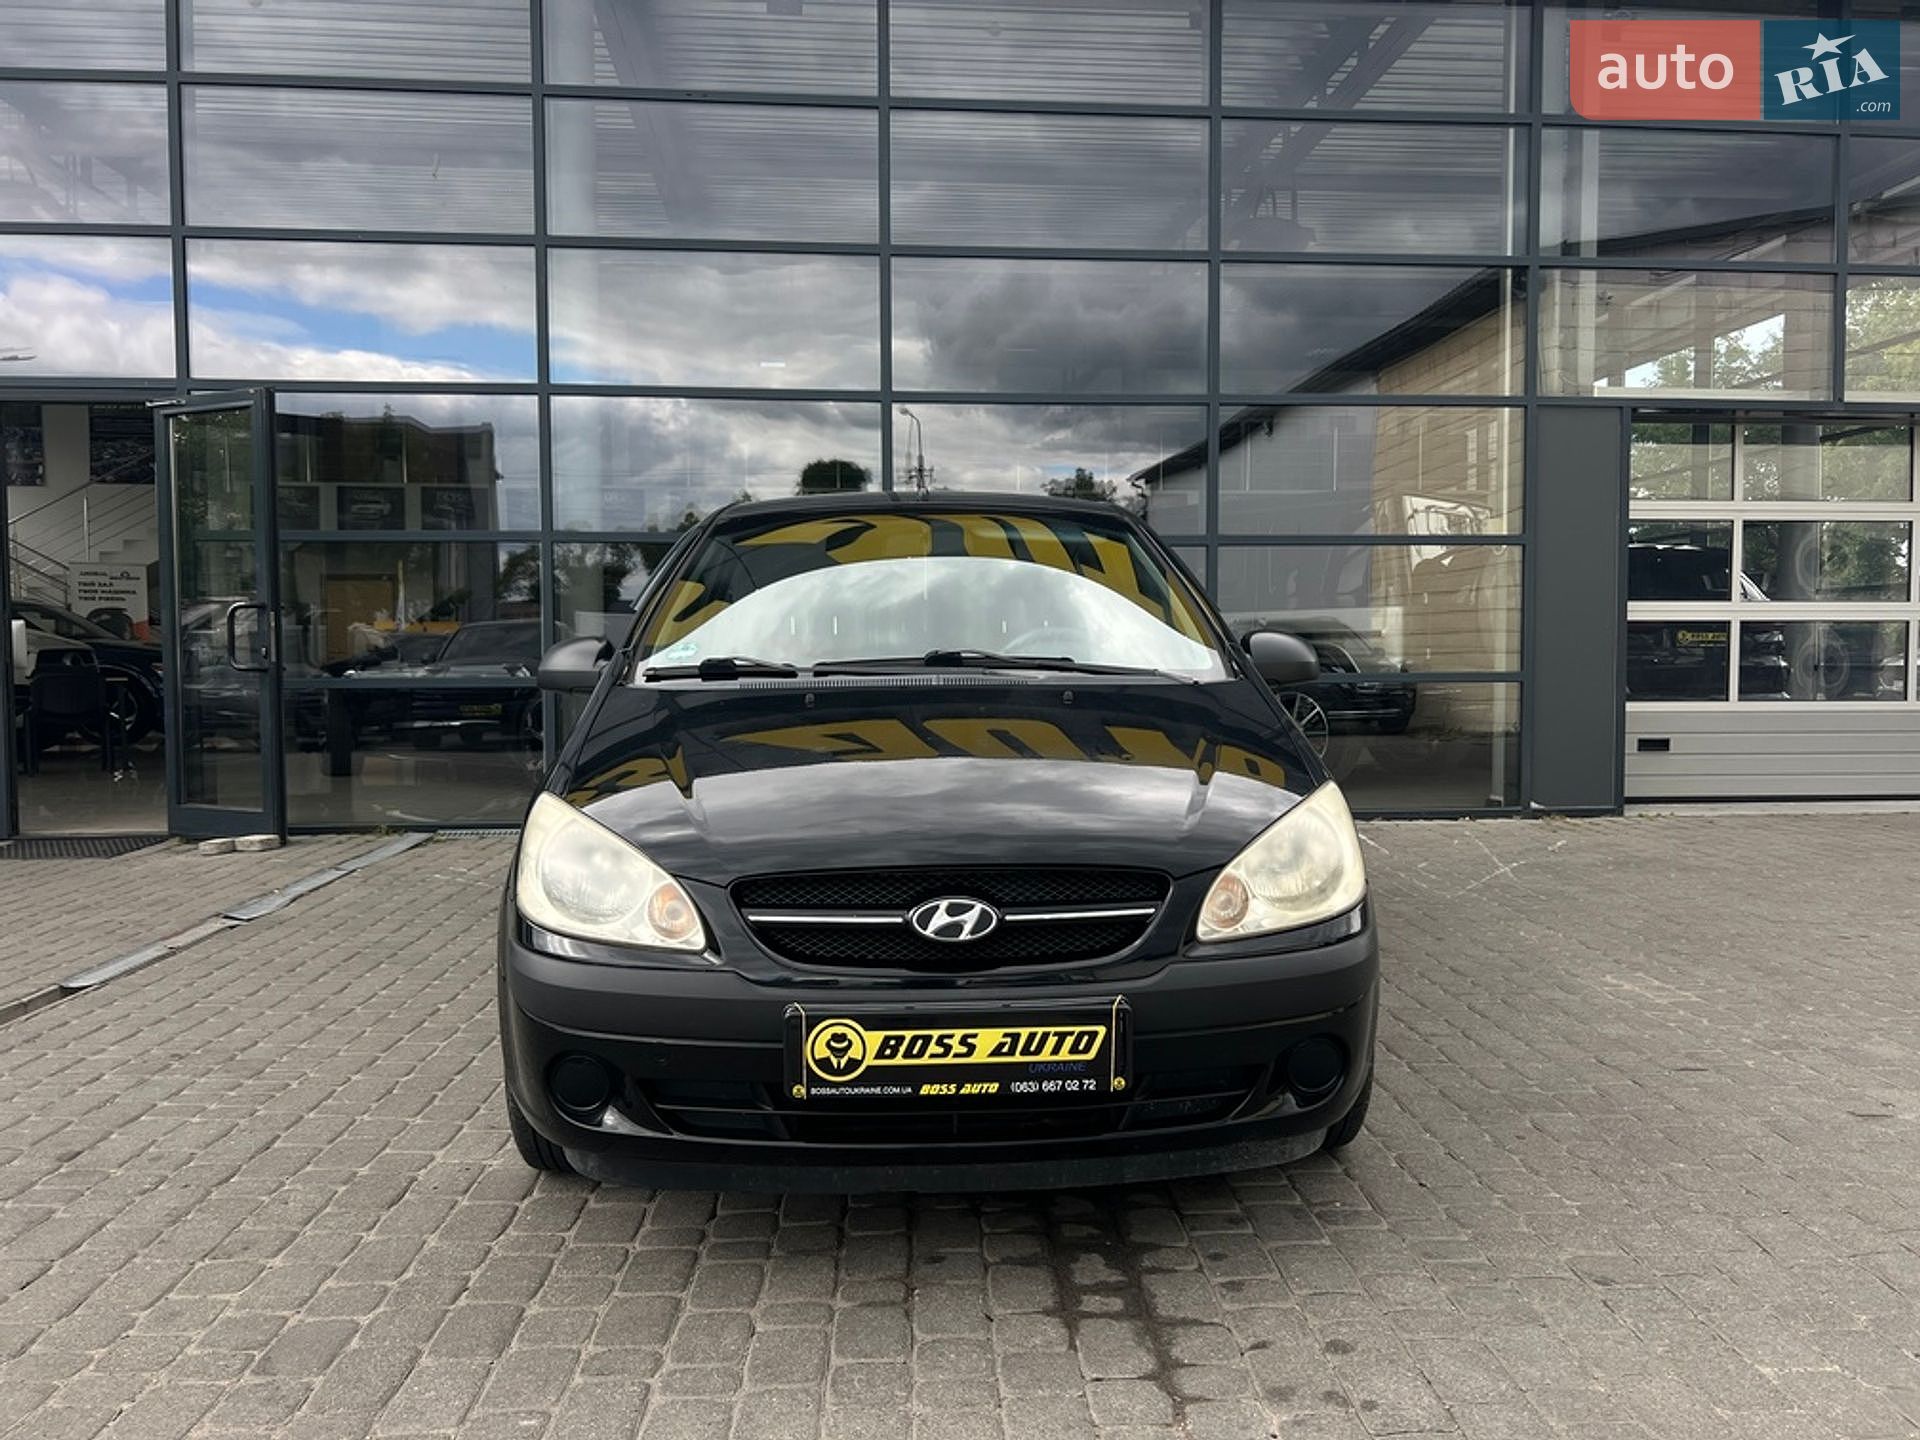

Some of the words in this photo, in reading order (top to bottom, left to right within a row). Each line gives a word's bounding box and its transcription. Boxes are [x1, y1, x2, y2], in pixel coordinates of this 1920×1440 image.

[873, 1033, 979, 1060] BOSS
[987, 1030, 1099, 1057] AUTO
[1028, 1063, 1087, 1073] UKRAINE
[919, 1083, 957, 1095] BOSS
[959, 1082, 1000, 1094] AUTO
[1010, 1081, 1039, 1093] (063)
[1041, 1080, 1062, 1092] 667
[1064, 1080, 1080, 1091] 02
[1083, 1079, 1097, 1091] 72
